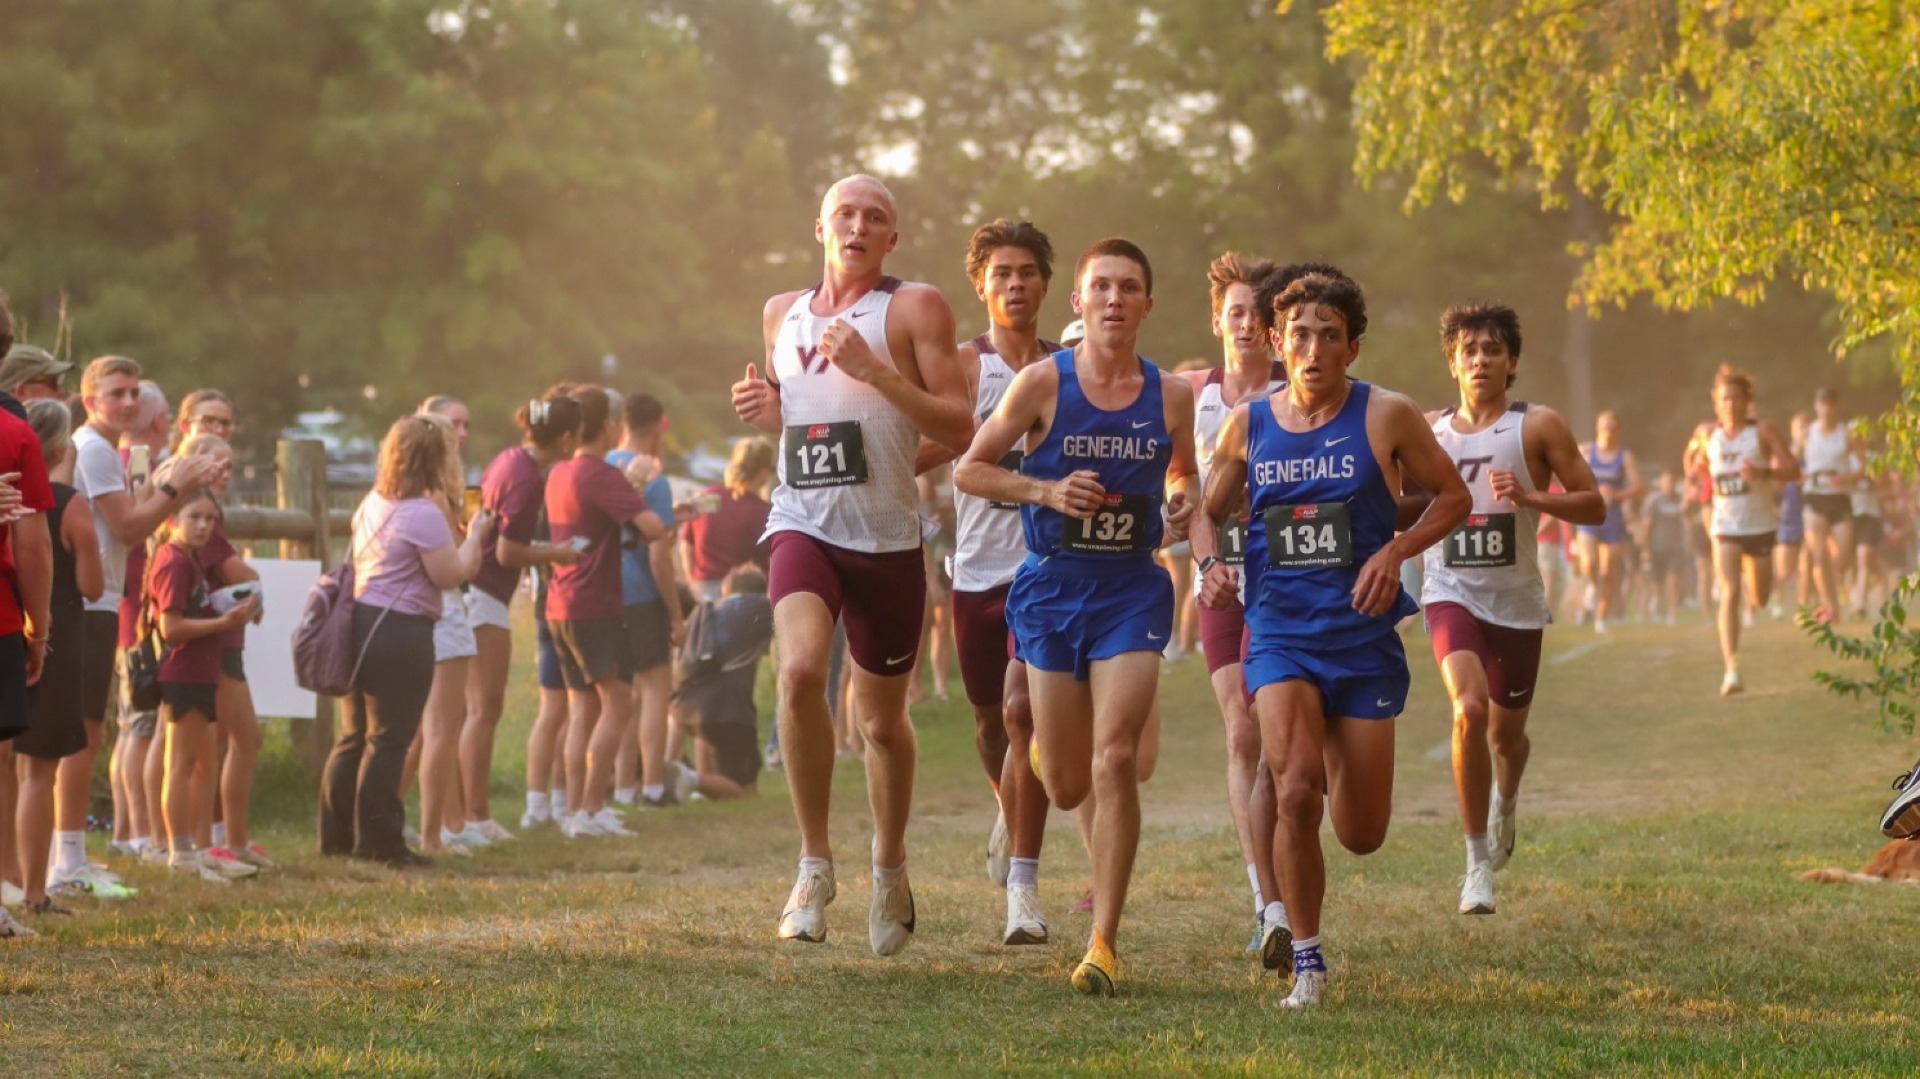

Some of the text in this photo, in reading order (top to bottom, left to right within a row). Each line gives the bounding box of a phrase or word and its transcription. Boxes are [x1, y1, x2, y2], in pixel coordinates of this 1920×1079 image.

[796, 441, 847, 475] 121
[1063, 435, 1158, 460] GENERALS
[1255, 454, 1355, 487] GENERALS
[1080, 512, 1134, 541] 132
[1279, 523, 1337, 555] 134
[1454, 530, 1503, 557] 118
